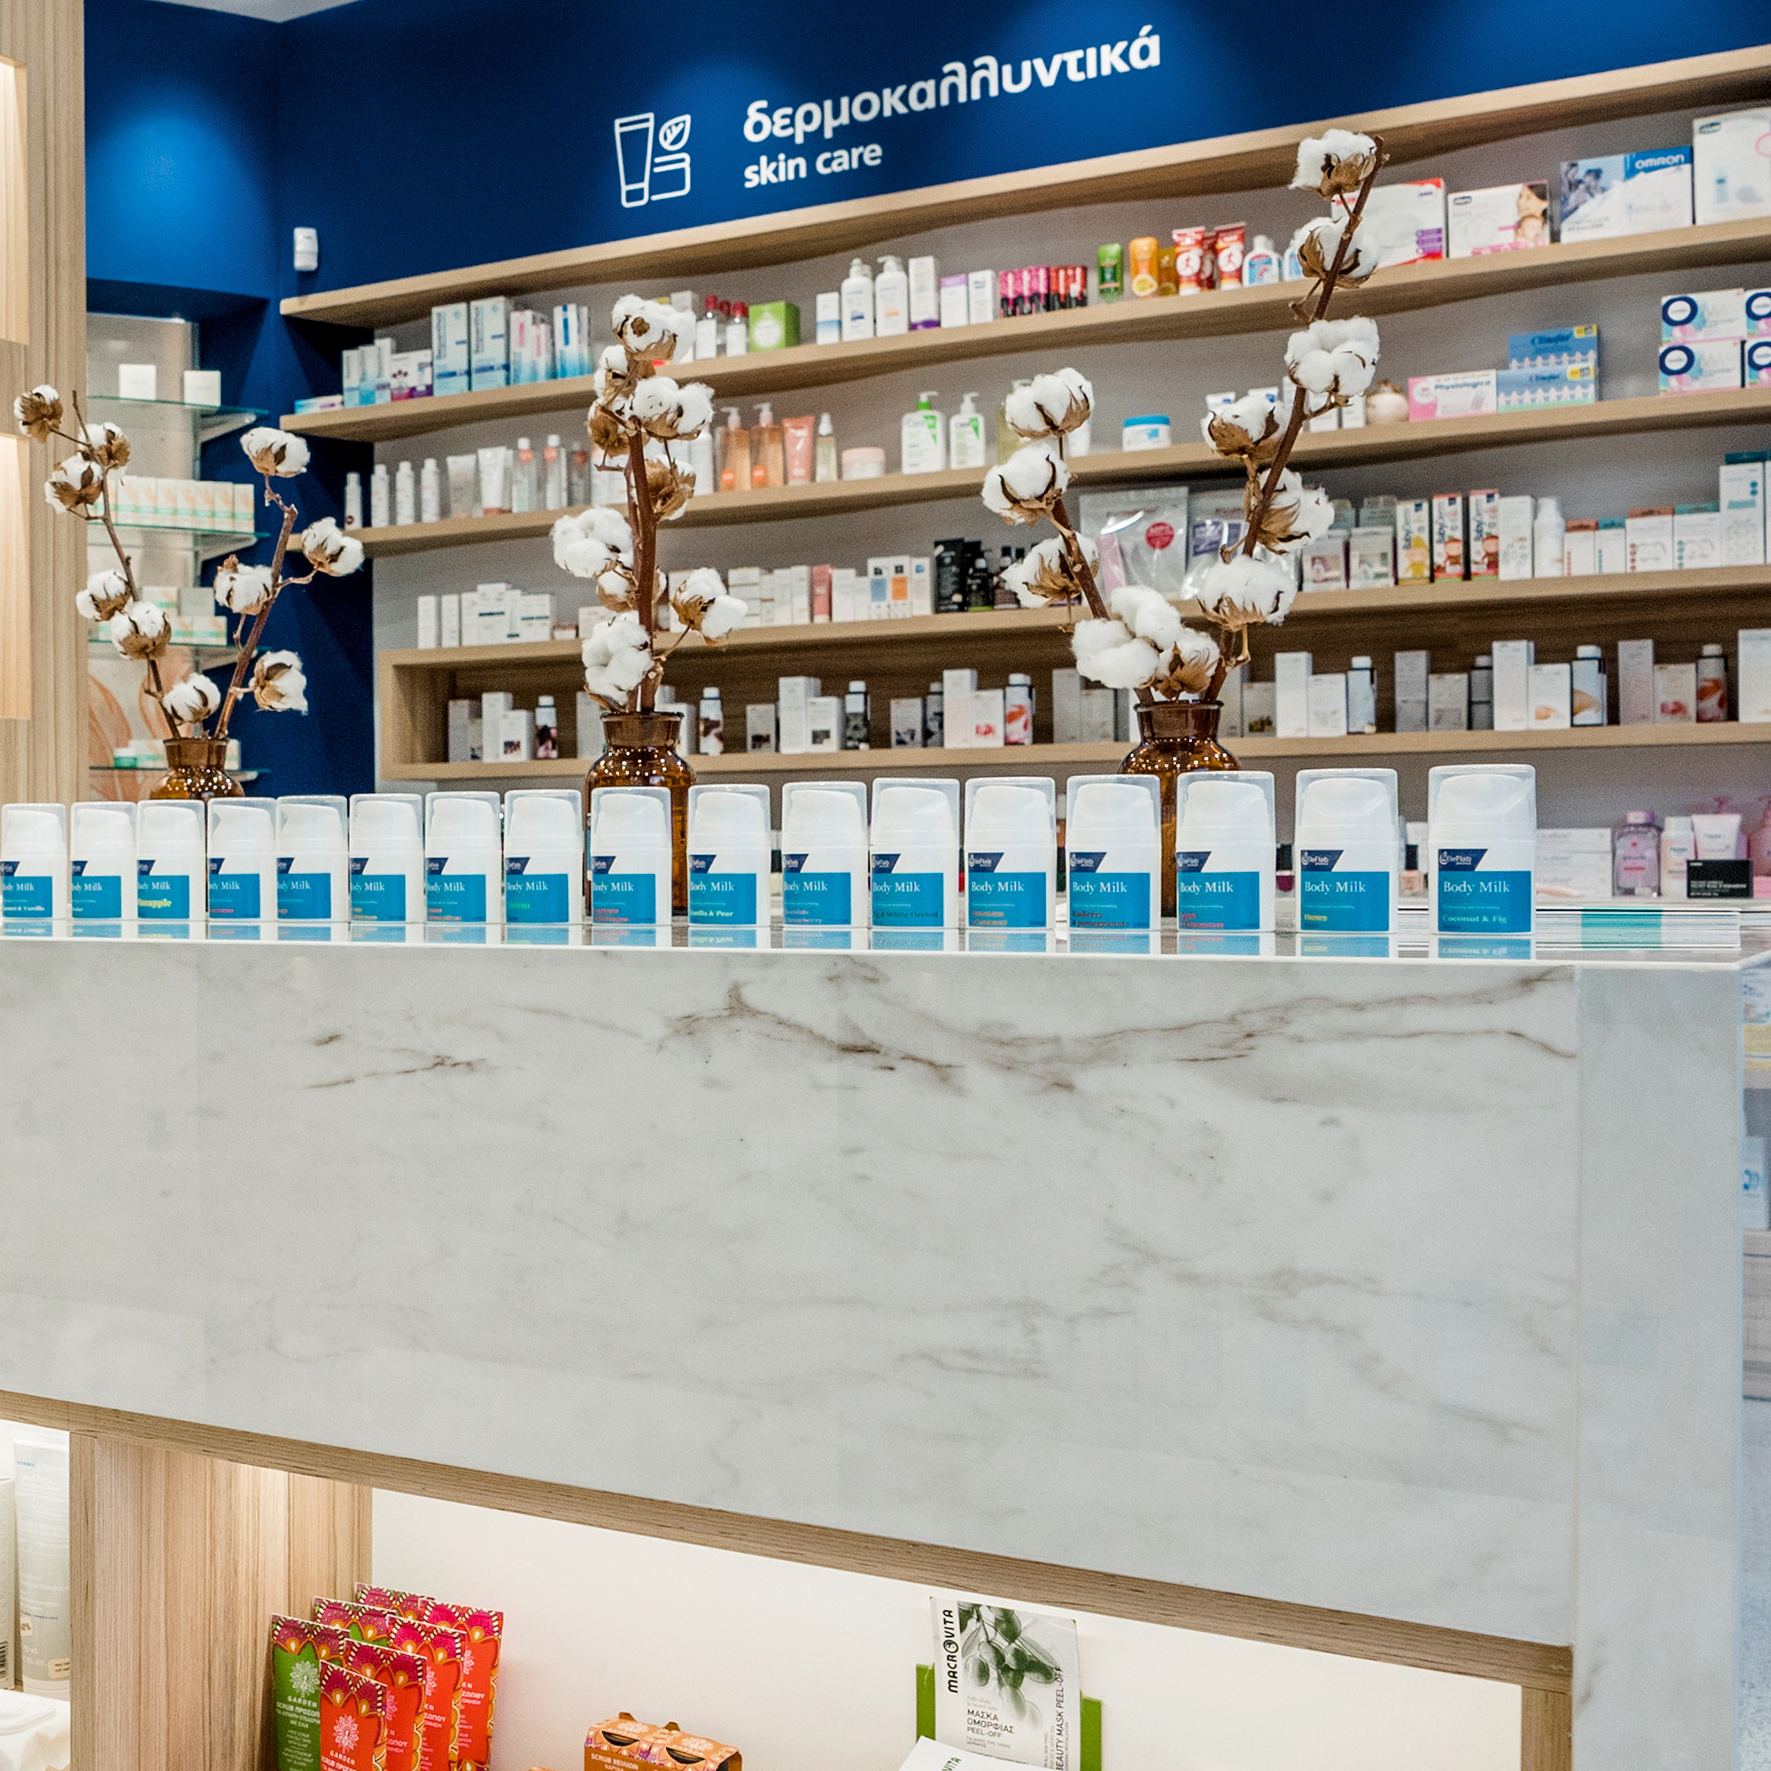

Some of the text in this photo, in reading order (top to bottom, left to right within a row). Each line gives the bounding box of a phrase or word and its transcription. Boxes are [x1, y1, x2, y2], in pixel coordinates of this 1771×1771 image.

[743, 24, 1161, 145] δερμοκαλλυντικά
[743, 143, 883, 189] skin care
[997, 881, 1024, 892] Milk
[1099, 881, 1127, 893] Milk
[1205, 881, 1234, 893] Milk
[1304, 880, 1366, 894] Body Milk
[1443, 880, 1510, 894] Body Milk
[967, 1708, 999, 1722] ΜΑΣΚΑ
[967, 1717, 1015, 1734] ΟΜΟΡΦΙΑΣ
[1055, 1739, 1065, 1771] BEAUTY
